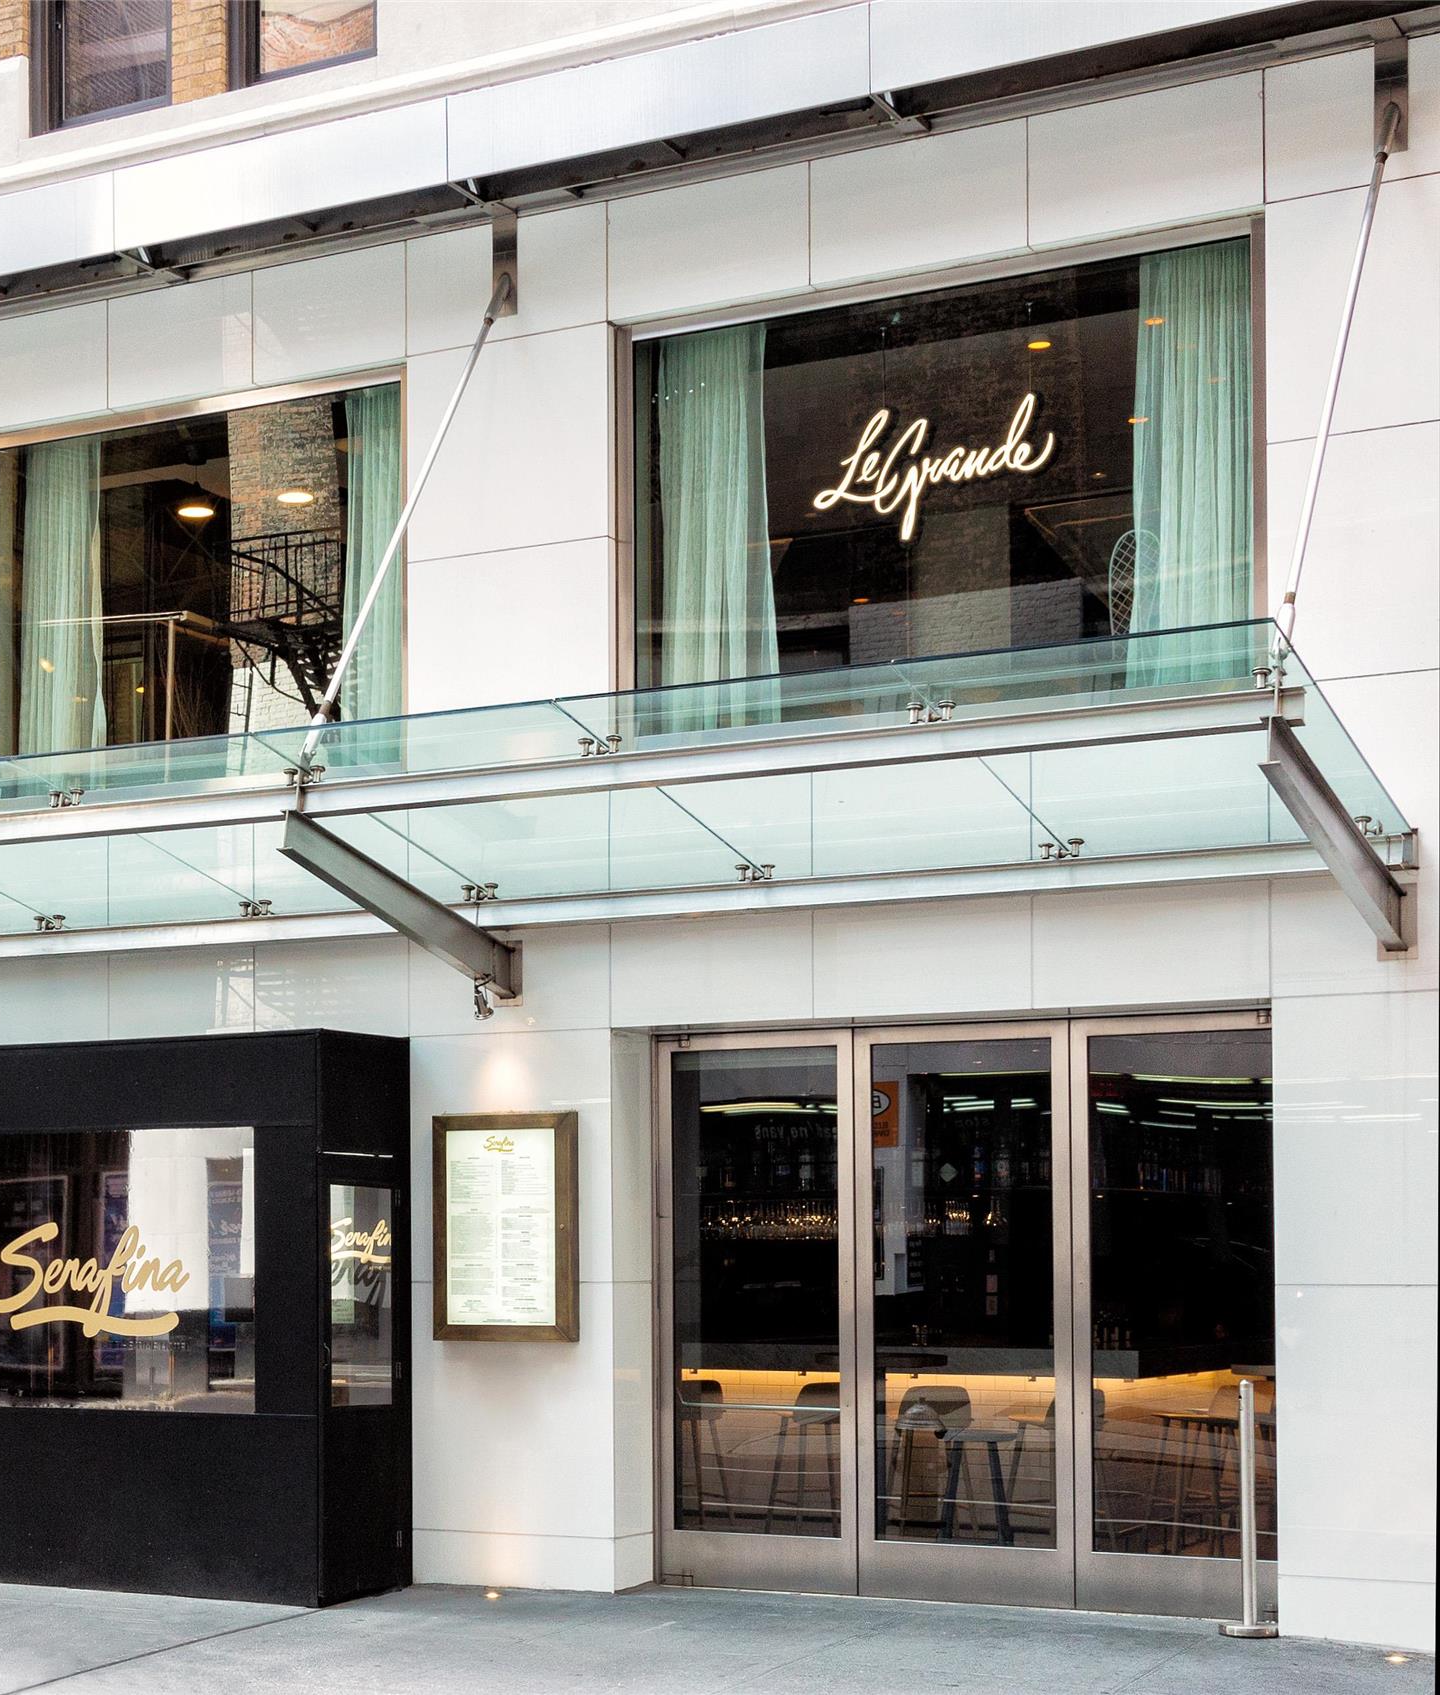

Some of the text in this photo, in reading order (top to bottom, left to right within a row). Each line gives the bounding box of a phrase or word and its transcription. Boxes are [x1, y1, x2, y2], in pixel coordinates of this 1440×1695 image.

[813, 393, 1054, 540] Le Grande
[331, 1217, 391, 1264] Serafin
